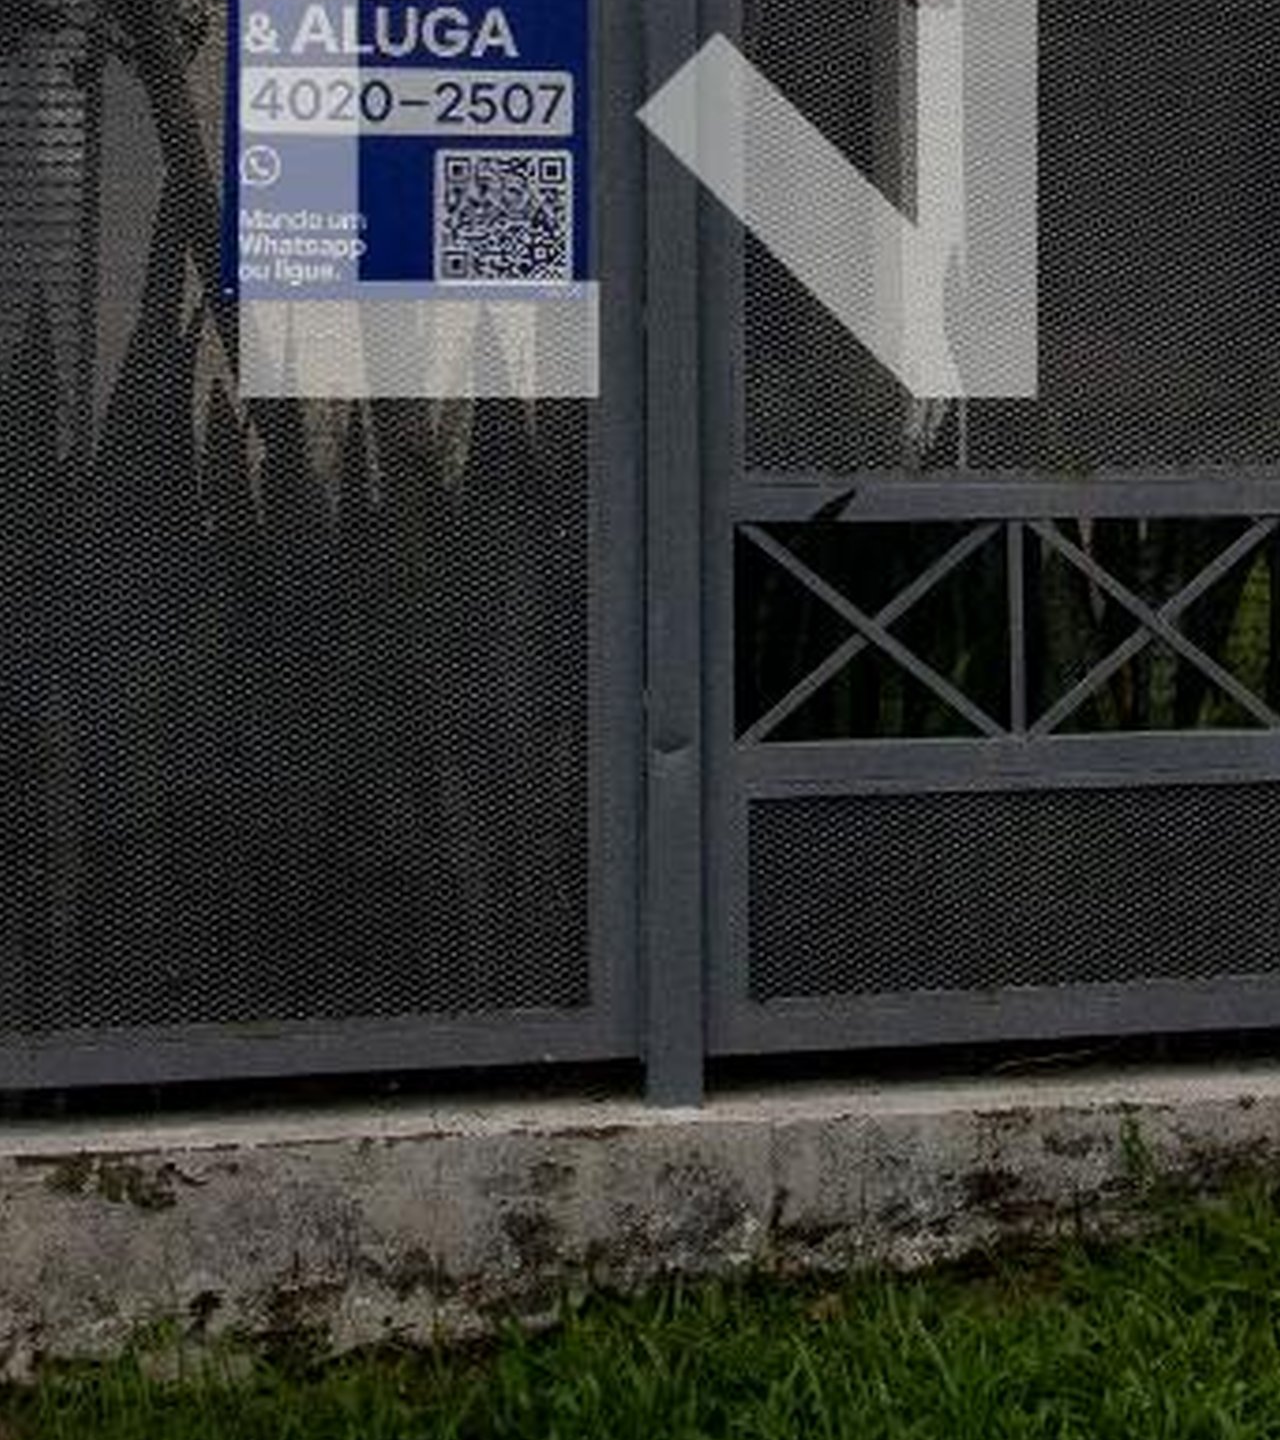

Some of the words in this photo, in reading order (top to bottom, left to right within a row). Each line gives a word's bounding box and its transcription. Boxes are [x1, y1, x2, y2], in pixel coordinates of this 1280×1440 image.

[243, 11, 281, 55] &
[291, 3, 520, 59] ALUGA
[249, 76, 567, 126] 4020-2507
